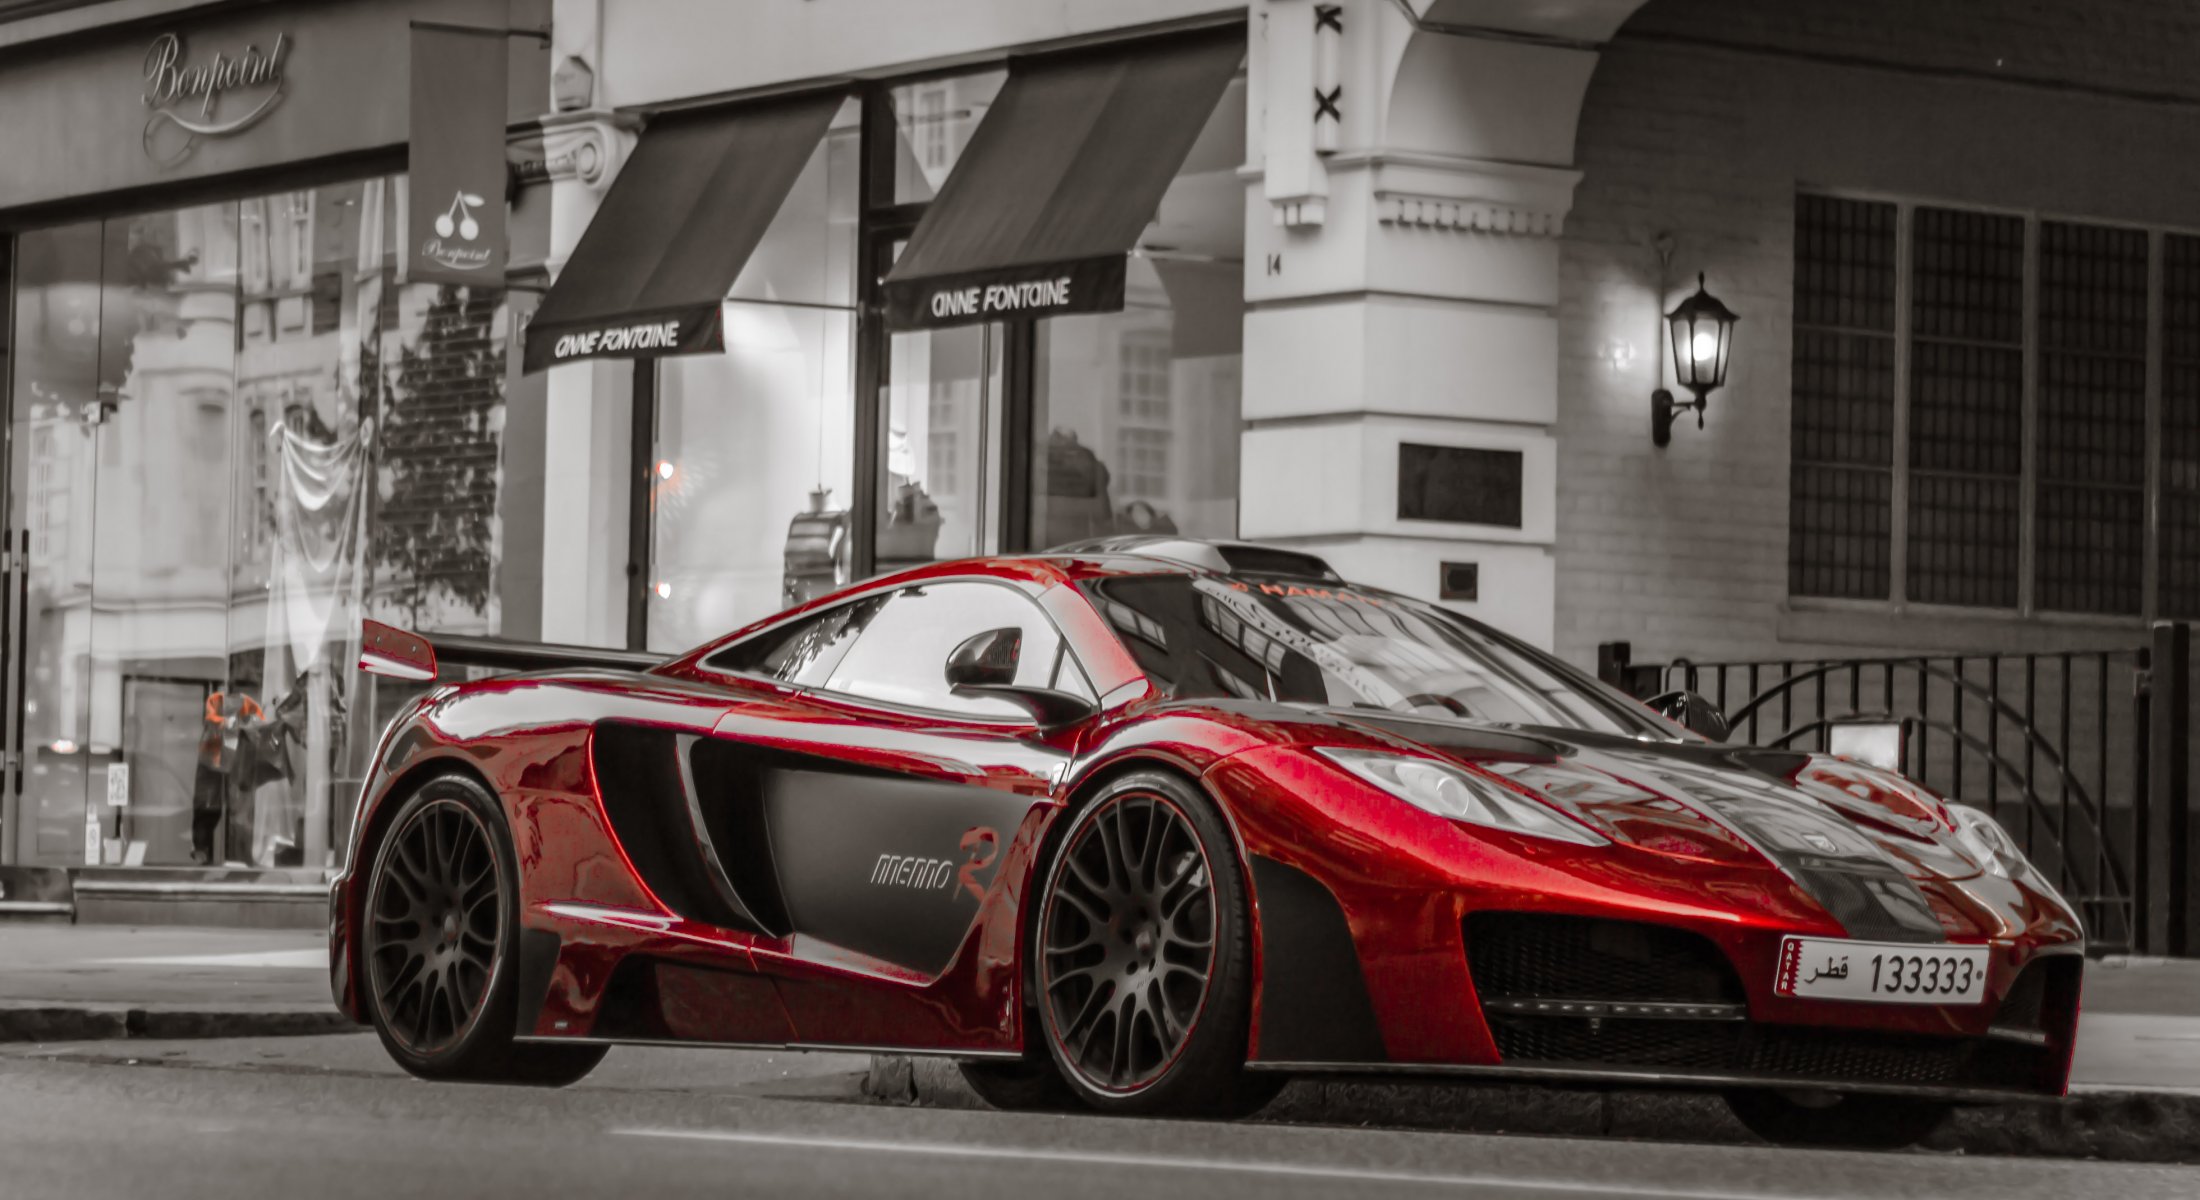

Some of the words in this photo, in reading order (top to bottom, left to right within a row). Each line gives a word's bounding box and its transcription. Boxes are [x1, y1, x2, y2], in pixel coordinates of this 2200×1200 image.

[142, 32, 290, 134] Bonpoint
[1804, 956, 1848, 984] قطر
[1872, 954, 1973, 994] 133333
